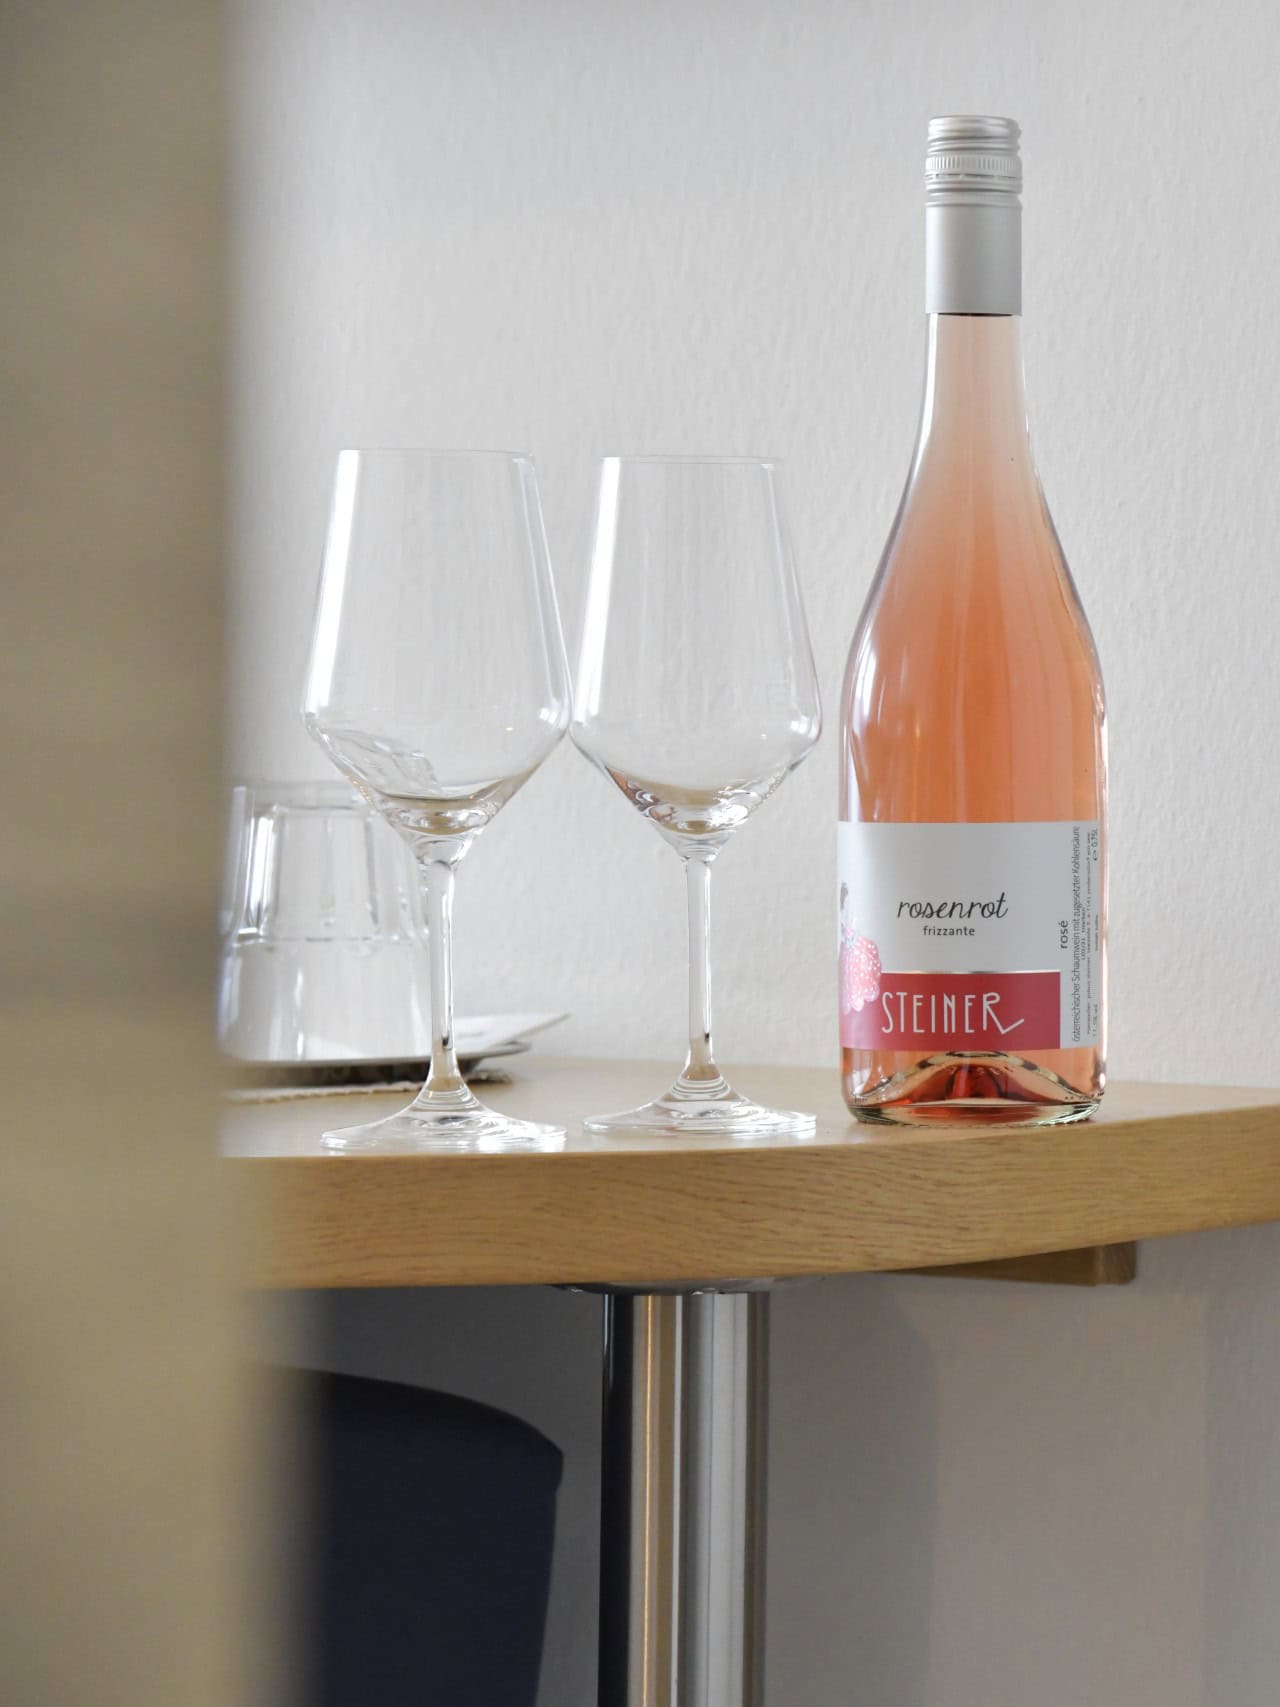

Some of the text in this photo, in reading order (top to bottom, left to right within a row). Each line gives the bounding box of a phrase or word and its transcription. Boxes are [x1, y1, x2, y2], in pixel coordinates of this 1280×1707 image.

[897, 892, 1009, 919] rosenrot
[923, 925, 975, 936] frizzante
[1058, 920, 1069, 949] rosé
[1071, 919, 1081, 931] mit
[1071, 932, 1081, 982] Schaumwein
[881, 991, 1024, 1034] STEINER
